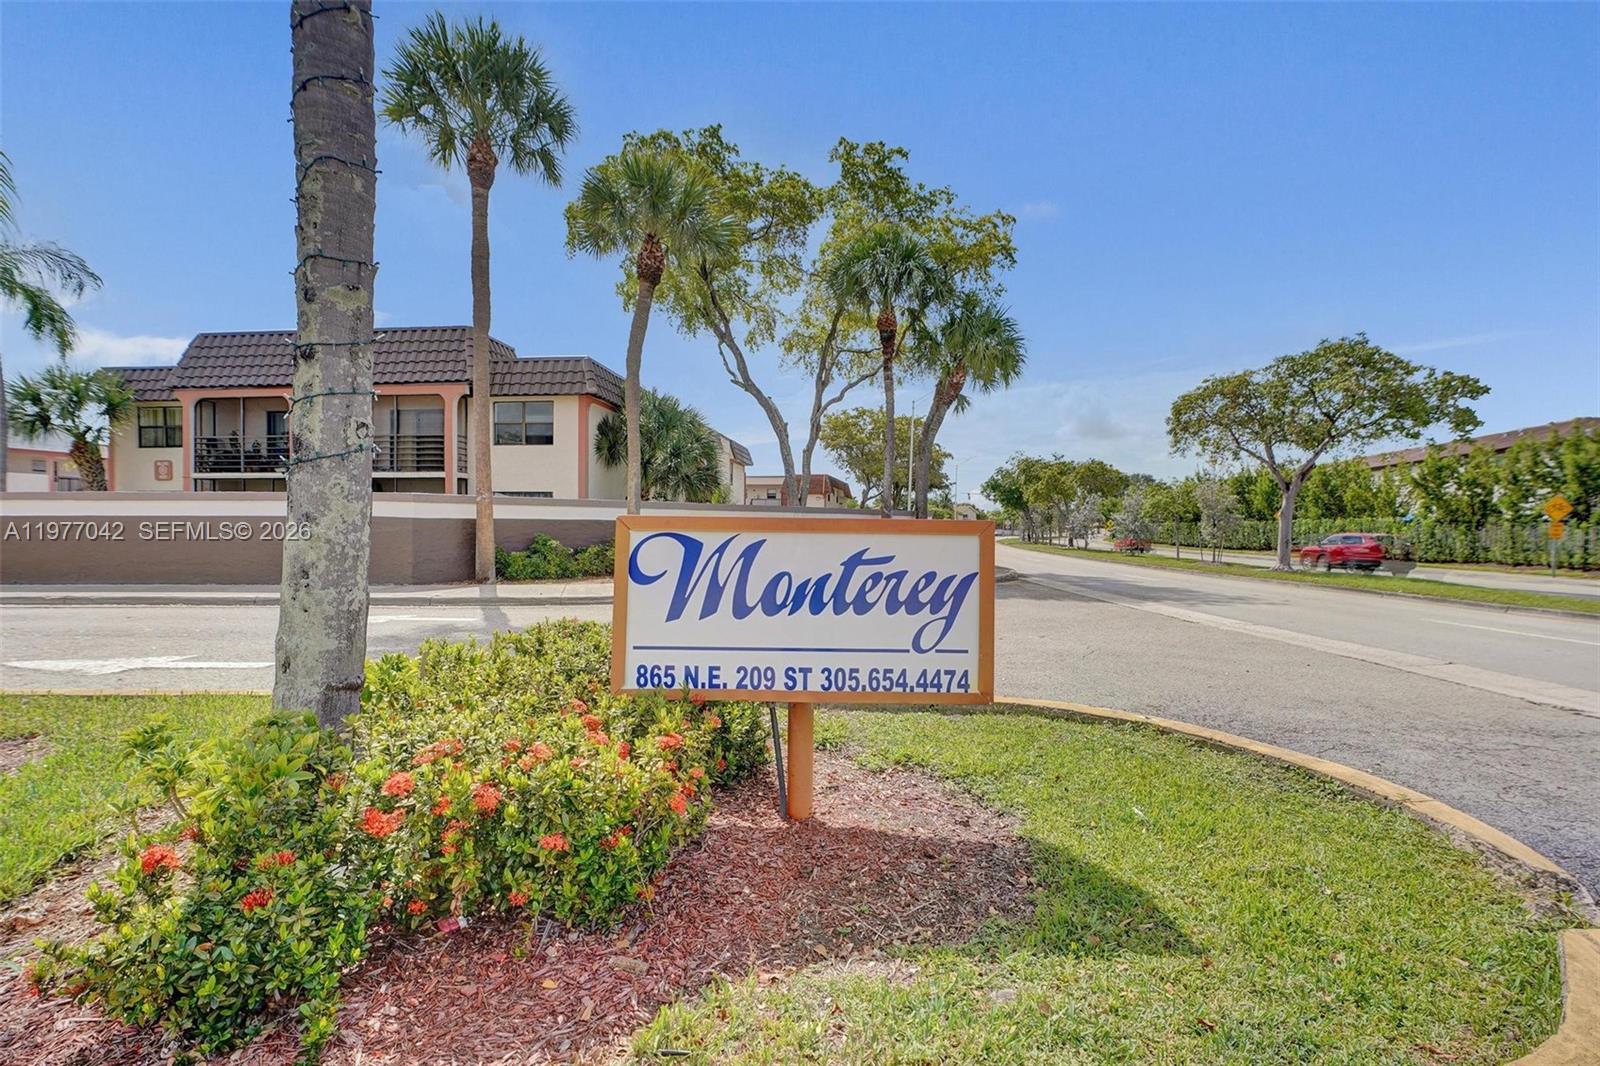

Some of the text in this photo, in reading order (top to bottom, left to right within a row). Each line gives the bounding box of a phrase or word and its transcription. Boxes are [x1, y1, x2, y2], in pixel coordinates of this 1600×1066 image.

[628, 532, 979, 655] Monterey
[636, 664, 970, 693] 865 N.E. 209 ST 305.654.4474
